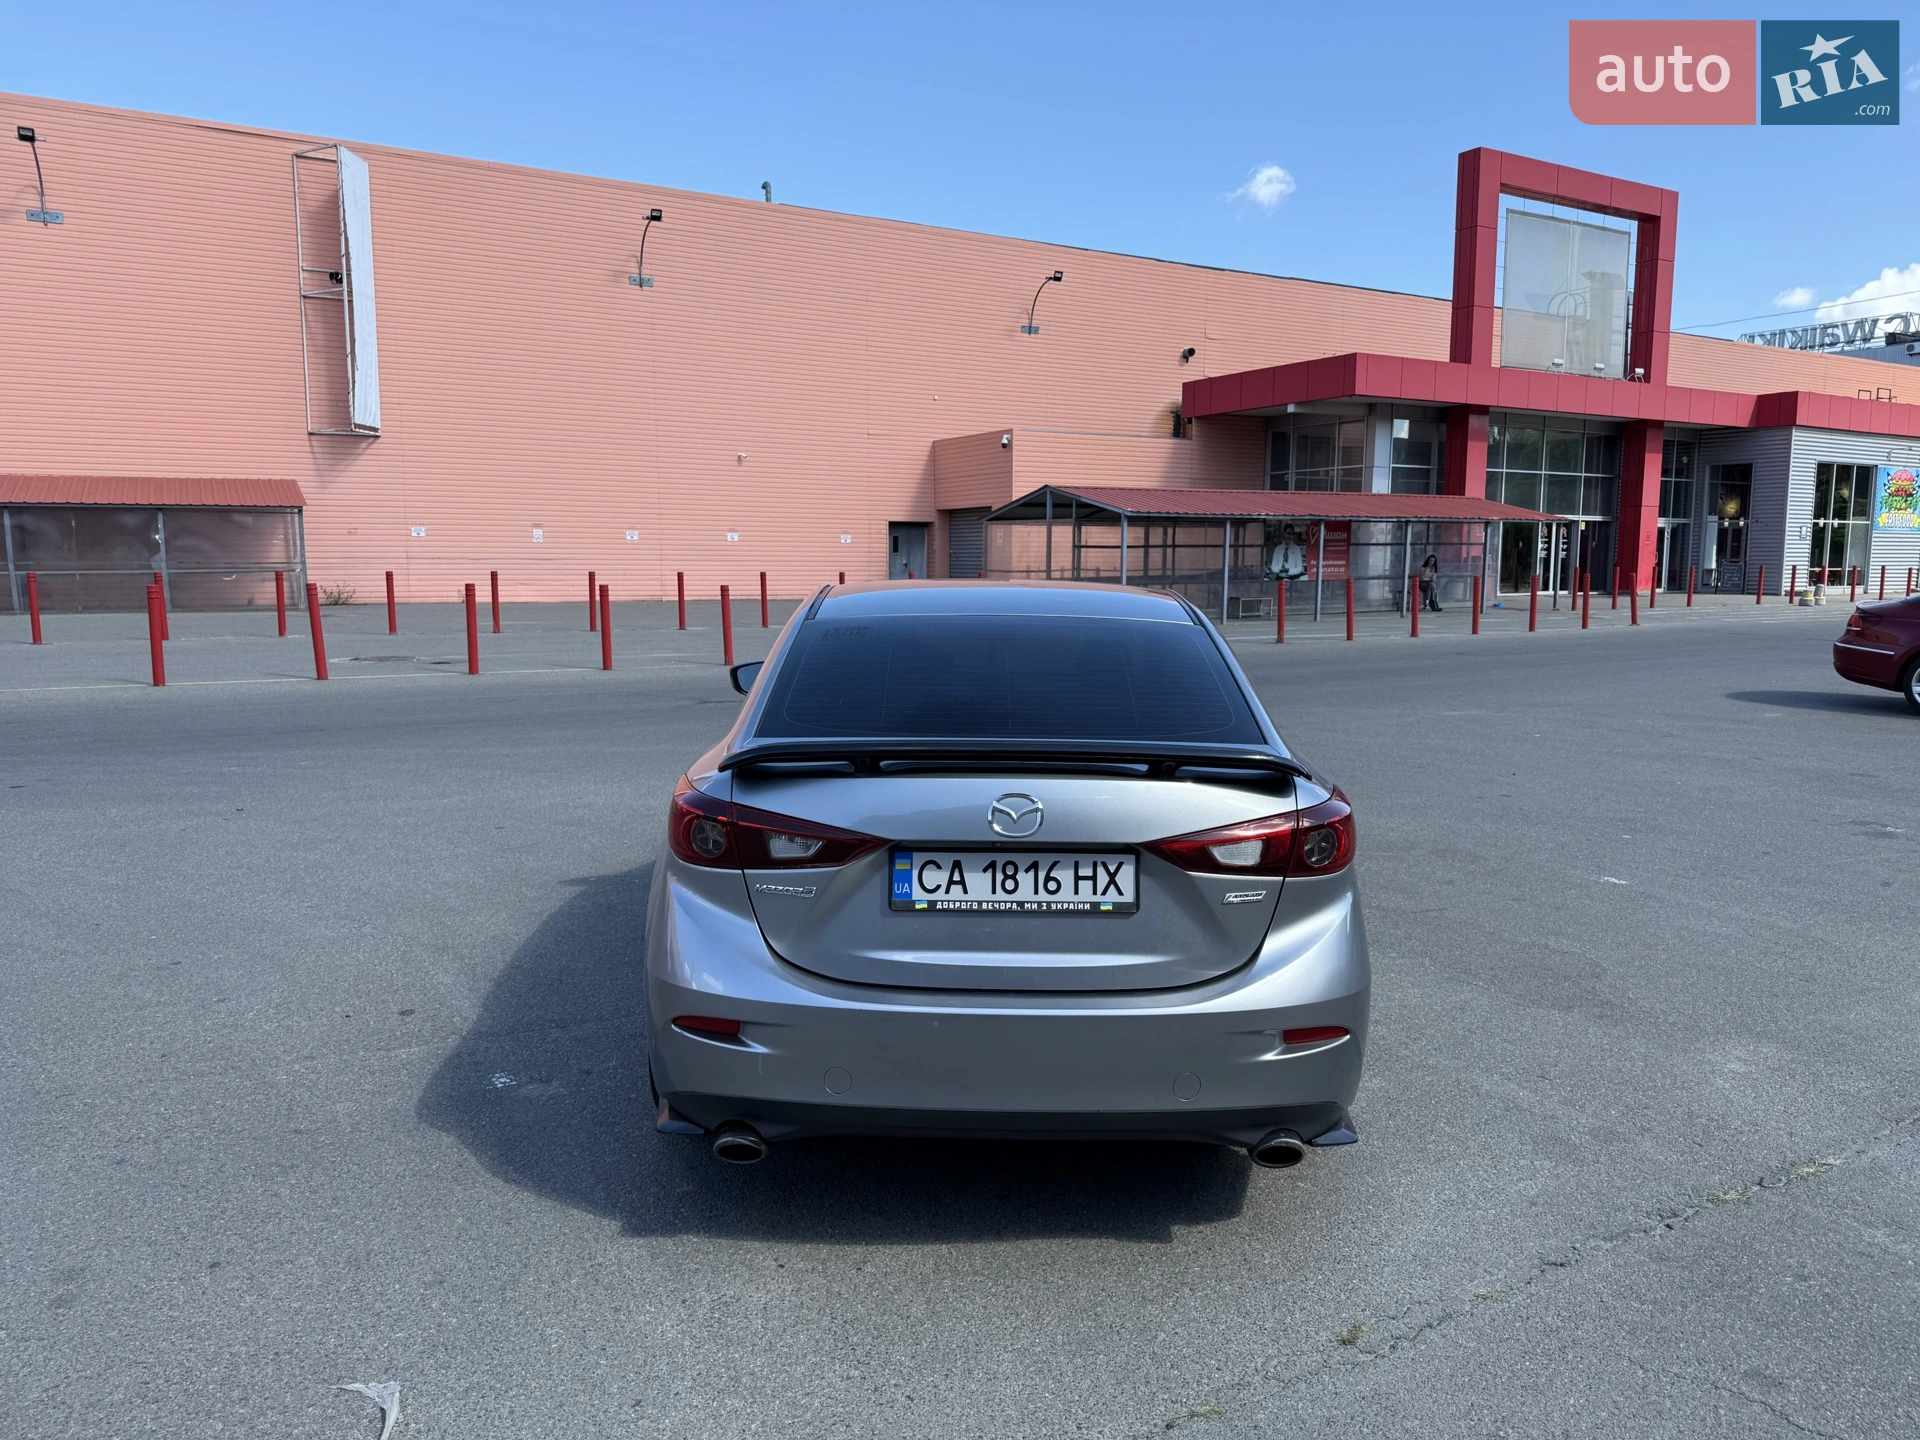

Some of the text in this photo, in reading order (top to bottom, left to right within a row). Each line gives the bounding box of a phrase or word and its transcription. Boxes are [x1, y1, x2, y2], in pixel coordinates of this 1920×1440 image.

[1885, 513, 1899, 527] FAST
[917, 859, 1125, 896] CA 1816 HX
[895, 883, 911, 894] UA
[936, 901, 978, 909] ДОБРОГО
[982, 902, 1021, 910] ВЕЧОРА,
[1024, 902, 1038, 910] МИ
[1051, 901, 1091, 910] УКРАЇНИ
